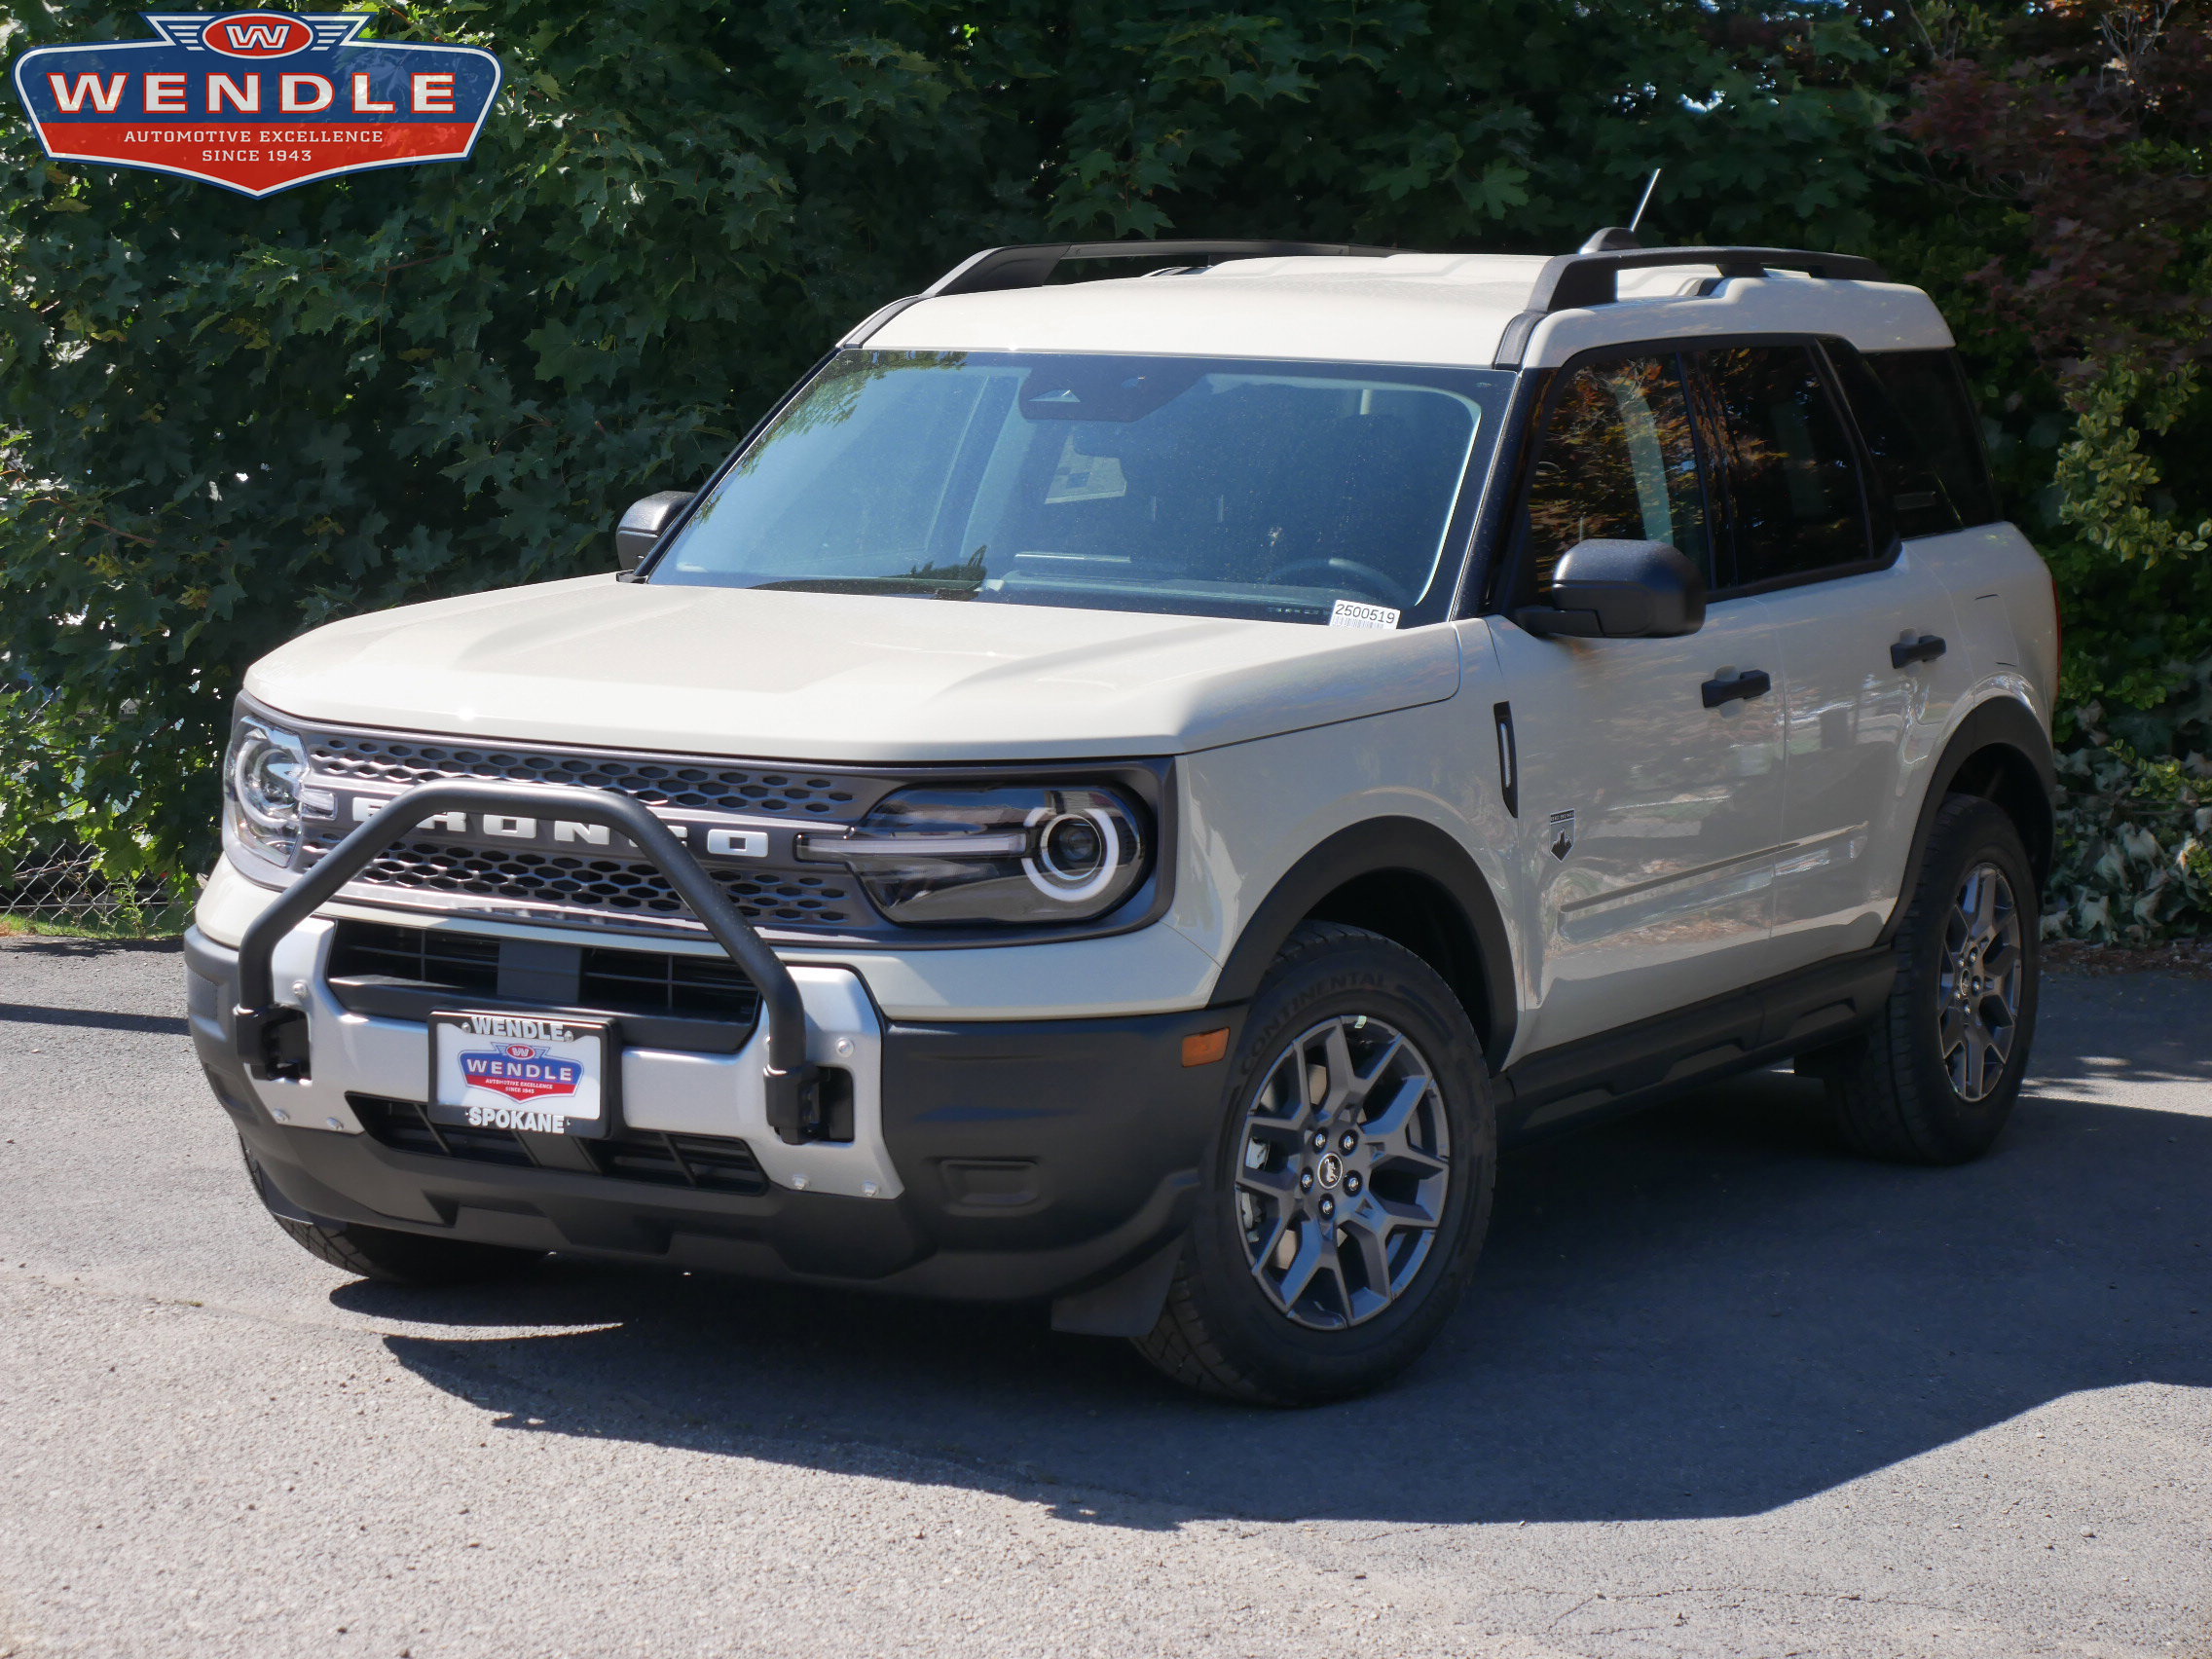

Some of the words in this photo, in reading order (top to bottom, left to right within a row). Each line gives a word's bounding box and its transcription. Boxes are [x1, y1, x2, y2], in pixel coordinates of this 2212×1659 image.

[1335, 604, 1395, 624] 2500519
[351, 796, 769, 858] BRONO
[471, 1016, 566, 1041] WENDLE
[1241, 971, 1386, 1074] CONTINENTAL
[466, 1058, 572, 1081] WENDLE
[468, 1106, 565, 1134] SPOKANE
